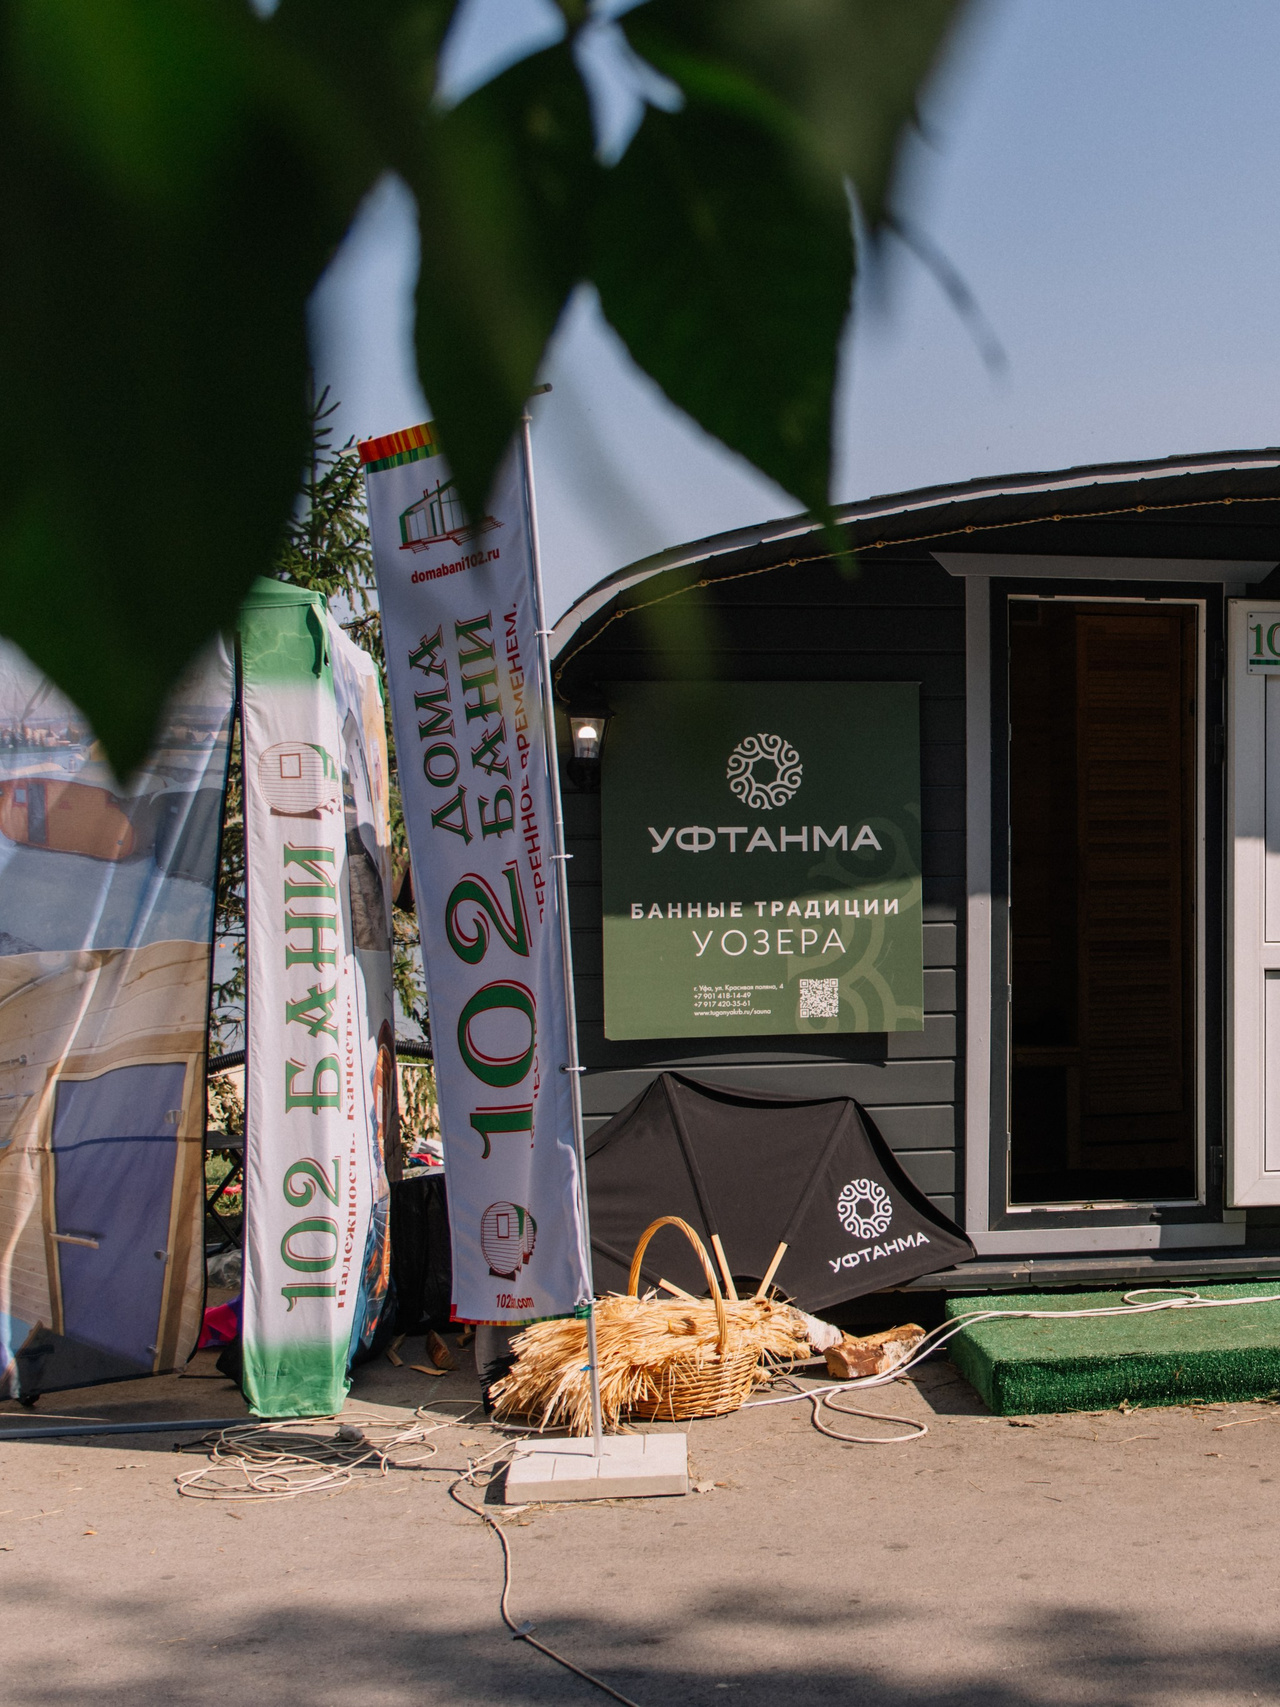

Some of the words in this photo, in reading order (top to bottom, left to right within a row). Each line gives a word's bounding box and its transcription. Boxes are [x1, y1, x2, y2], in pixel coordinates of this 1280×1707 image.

[410, 548, 500, 584] domabani102.ru
[408, 623, 474, 846] ДОМА
[455, 609, 516, 841] БАНИ
[647, 825, 883, 853] УФТАНМА
[631, 902, 743, 919] БАННЫЕ
[754, 898, 900, 919] ТРАДИЦИИ
[720, 928, 846, 957] ОЗЕРА
[284, 841, 342, 1116] БАНИ
[724, 984, 754, 992] Красивая
[445, 860, 537, 1159] 102
[717, 1000, 751, 1008] 420-35-61
[280, 1156, 342, 1312] 102
[828, 1231, 931, 1274] УФТАНМА
